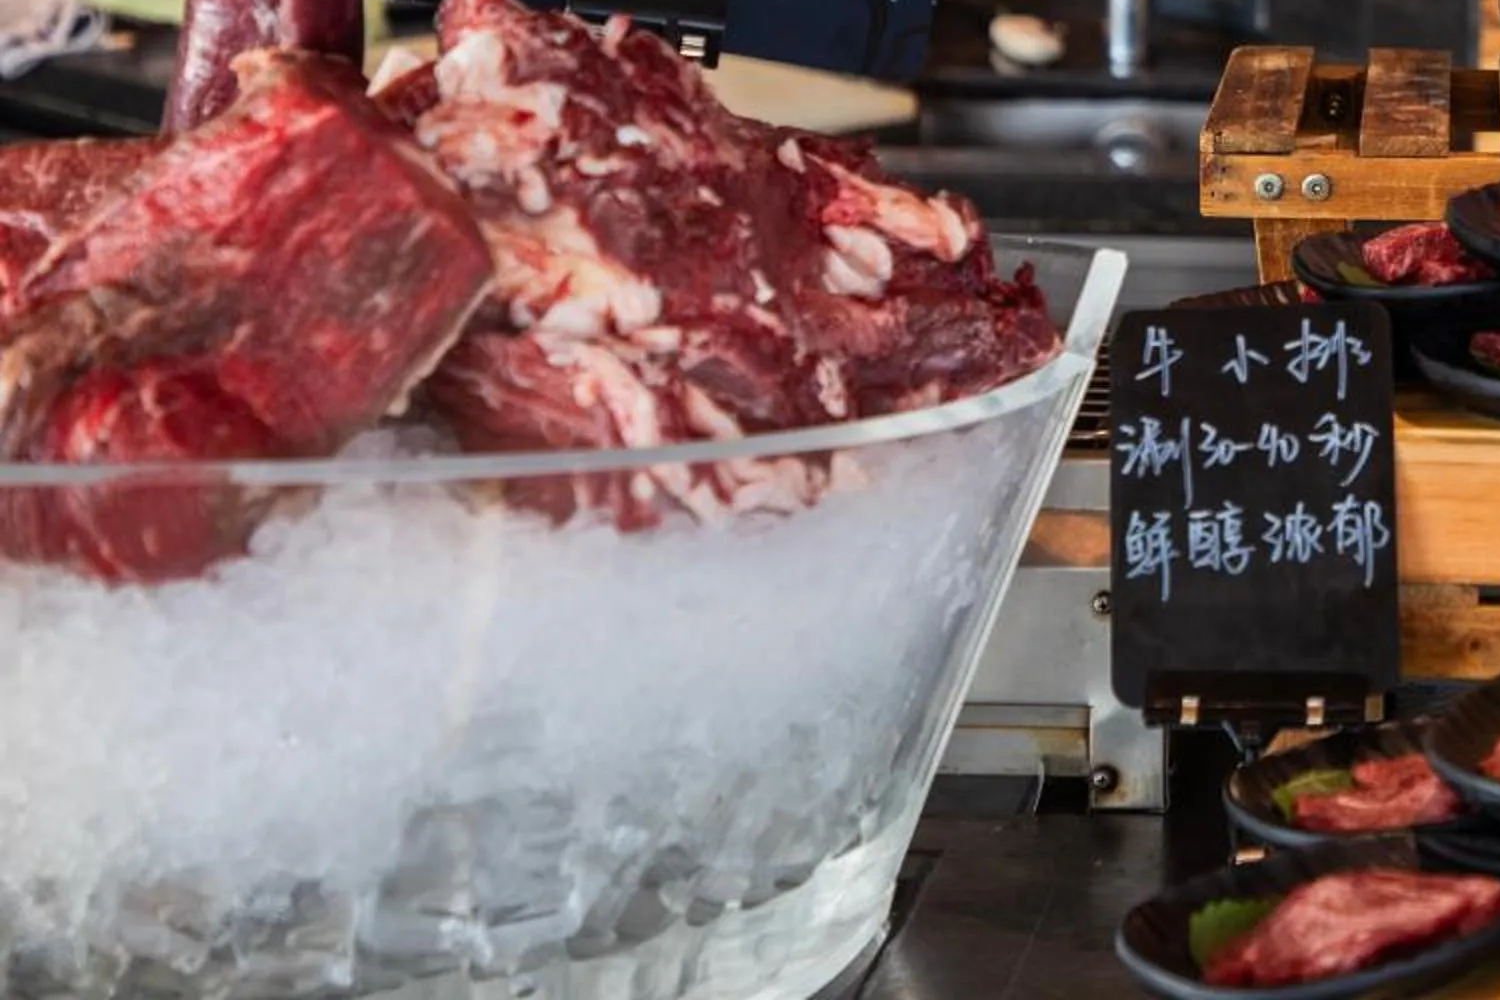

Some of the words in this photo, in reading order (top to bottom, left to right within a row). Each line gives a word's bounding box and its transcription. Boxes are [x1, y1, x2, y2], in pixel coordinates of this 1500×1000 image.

[1136, 318, 1372, 400] 牛小排
[1125, 496, 1391, 602] 鲜醇浓郁
